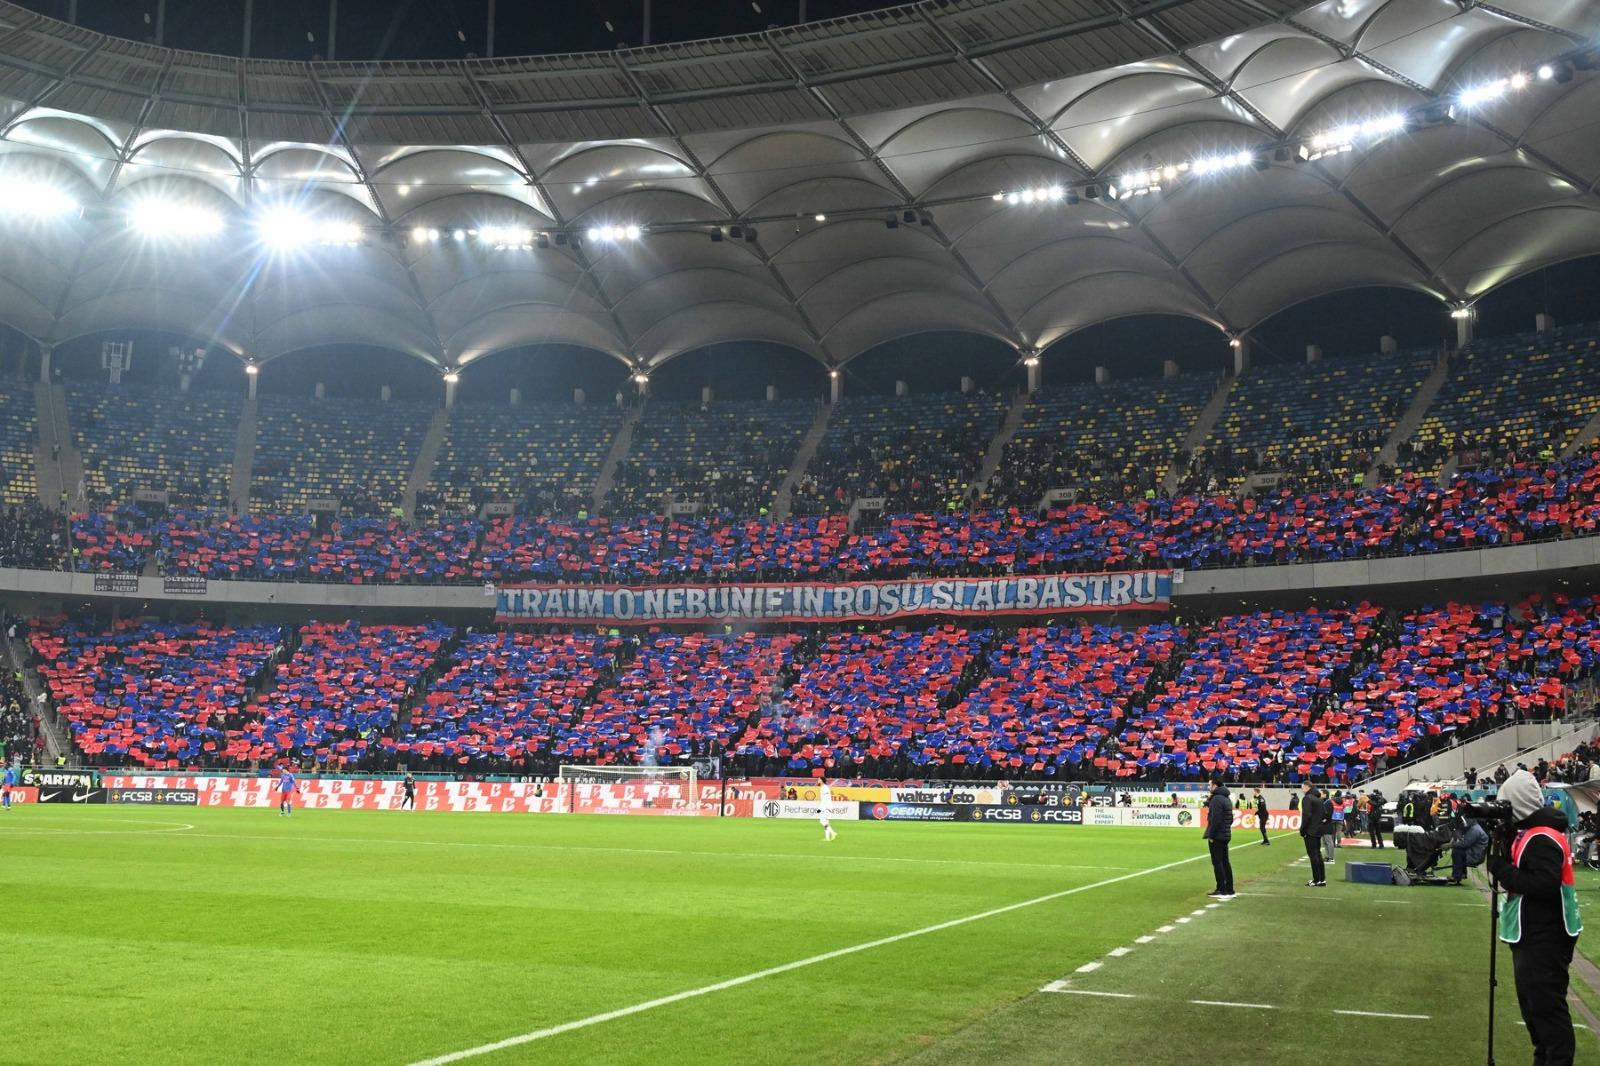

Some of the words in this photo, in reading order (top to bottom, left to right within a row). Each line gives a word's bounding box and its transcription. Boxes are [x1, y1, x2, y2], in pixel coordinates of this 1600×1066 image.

[503, 588, 604, 618] TRAIM
[613, 588, 635, 620] O
[643, 586, 784, 618] NEBUNIE
[792, 586, 827, 618] IN
[832, 583, 925, 618] ROSU
[929, 580, 967, 611] SI
[971, 571, 1157, 611] ALBASTRU
[122, 791, 152, 802] FCSB
[165, 792, 195, 802] FCSB
[896, 790, 938, 803] walter
[939, 791, 975, 803] tsto
[984, 808, 1022, 820] FCSB
[1043, 810, 1081, 821] FCSB
